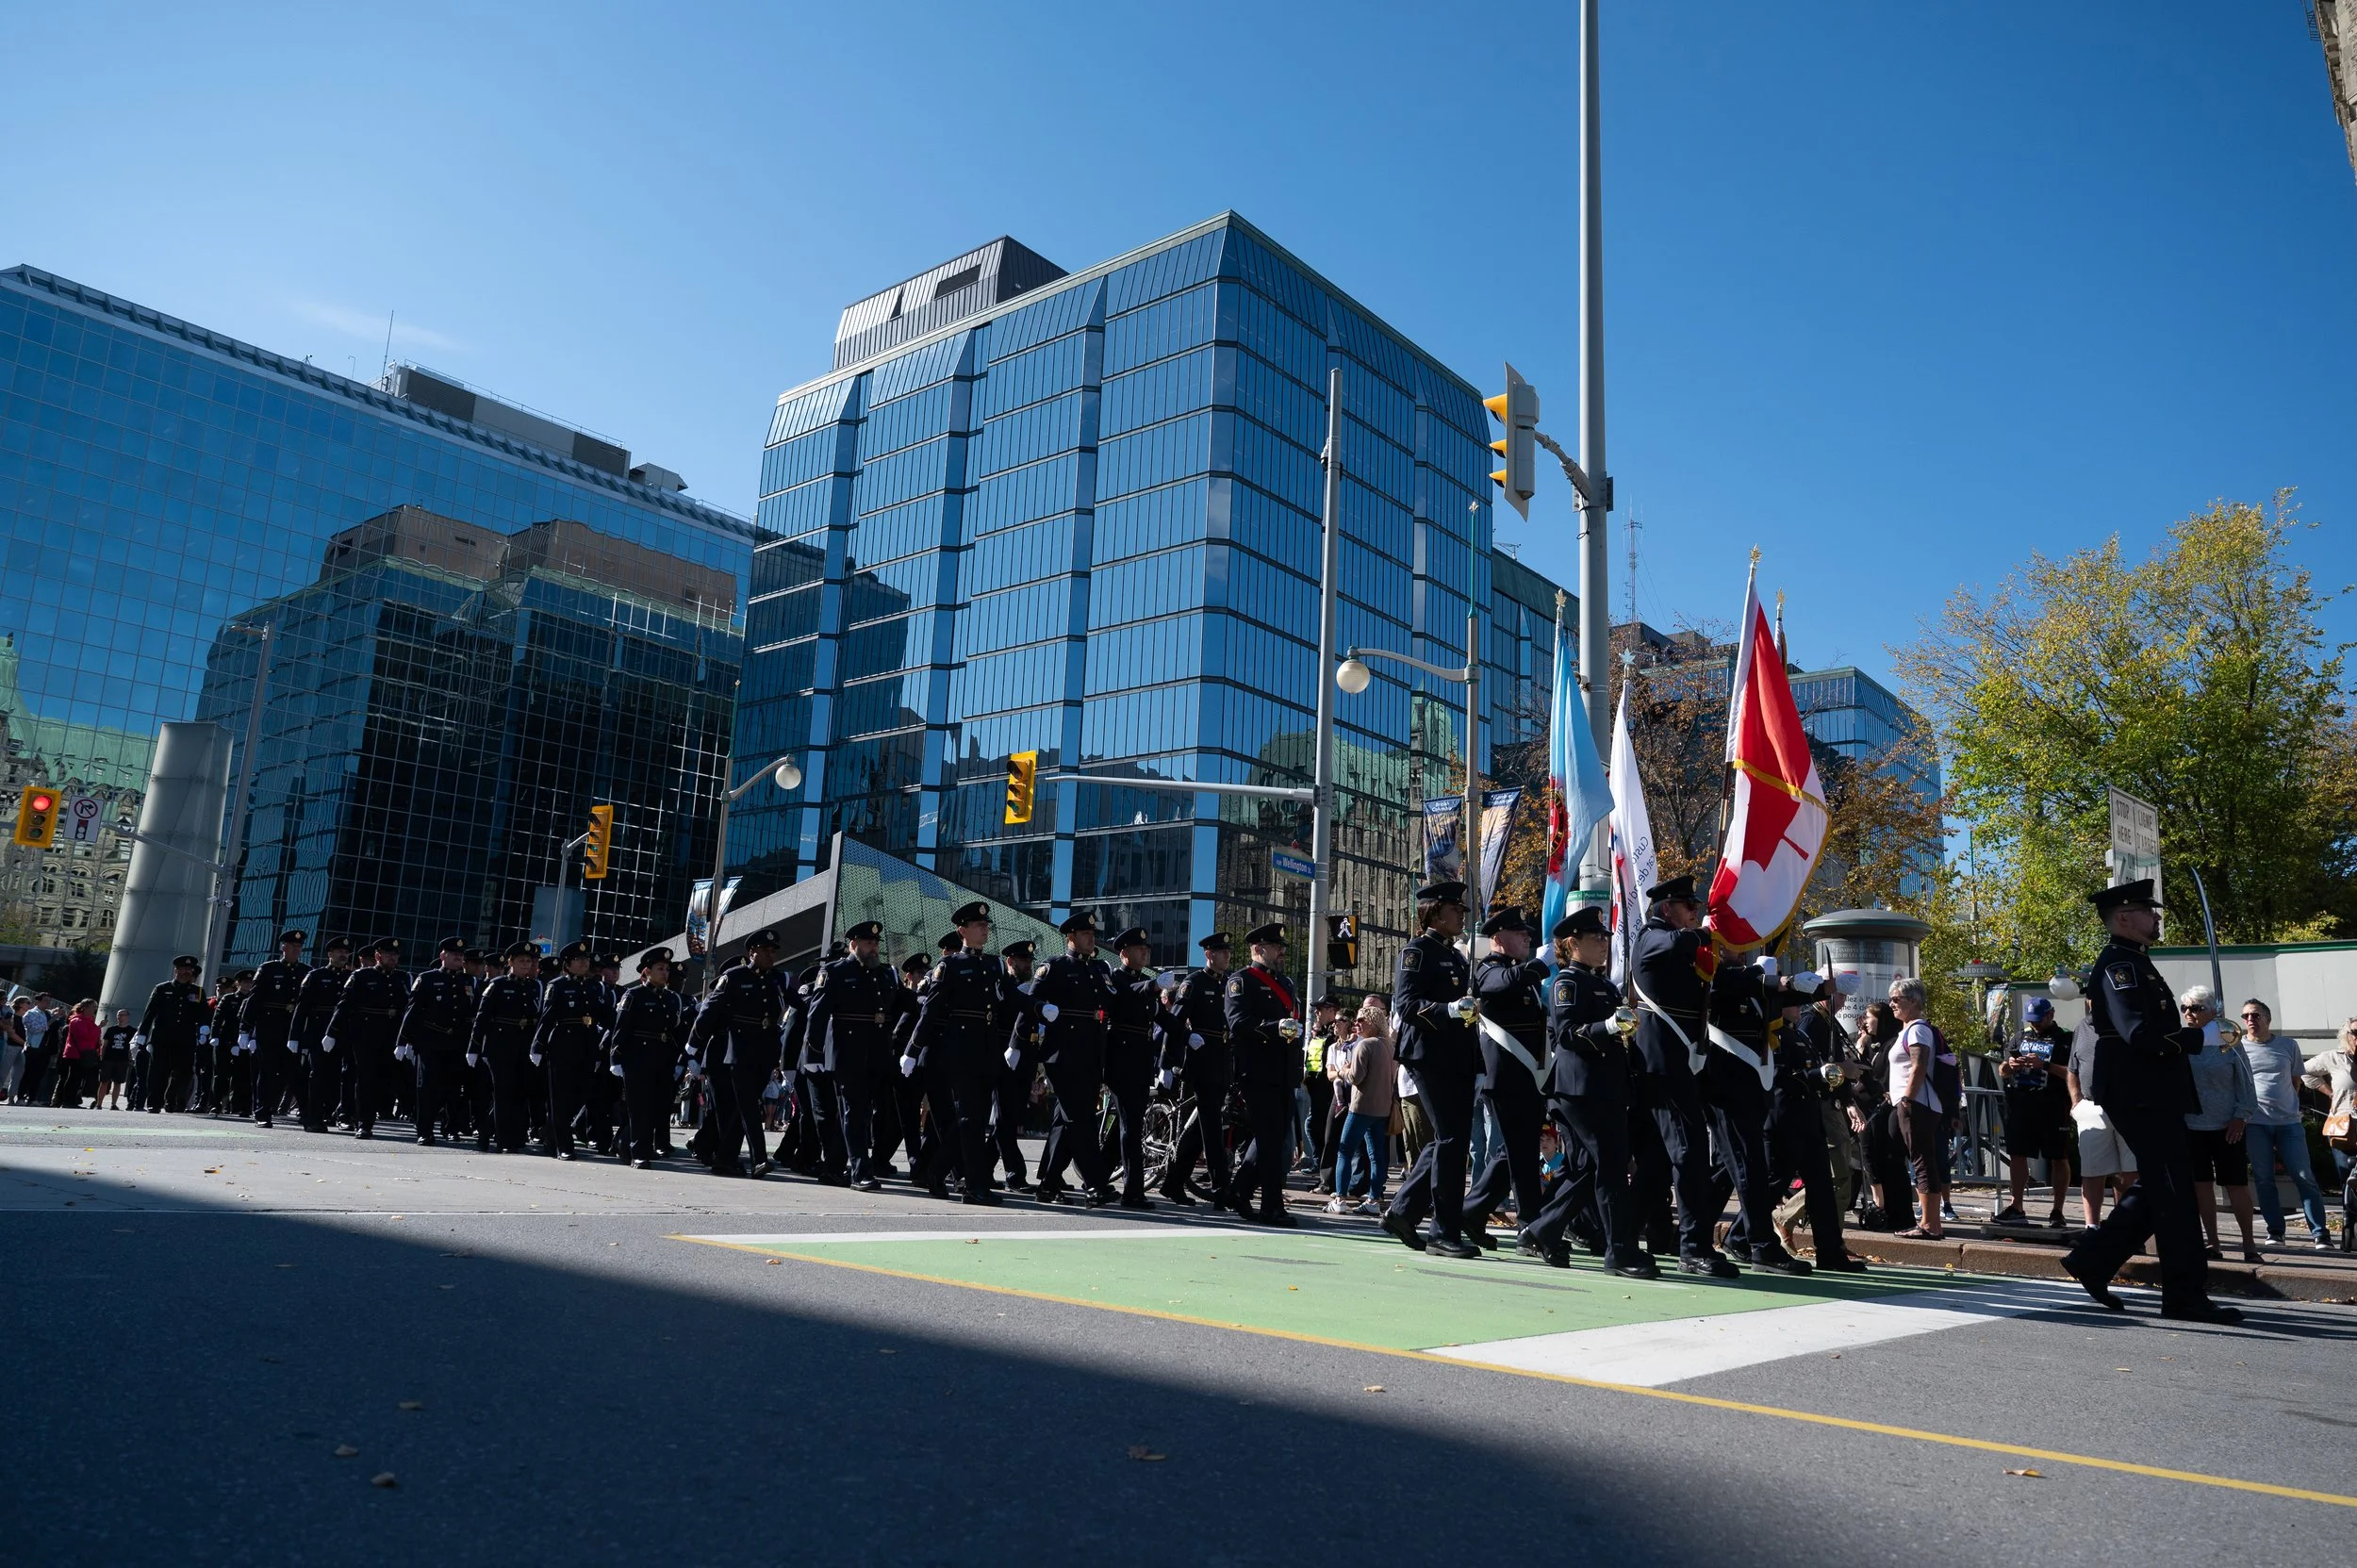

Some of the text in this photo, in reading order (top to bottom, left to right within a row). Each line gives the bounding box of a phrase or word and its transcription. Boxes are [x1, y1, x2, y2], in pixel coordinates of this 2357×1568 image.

[2116, 799, 2130, 820] STOP
[2117, 823, 2132, 846] HERE
[1282, 856, 1308, 873] Wellington
